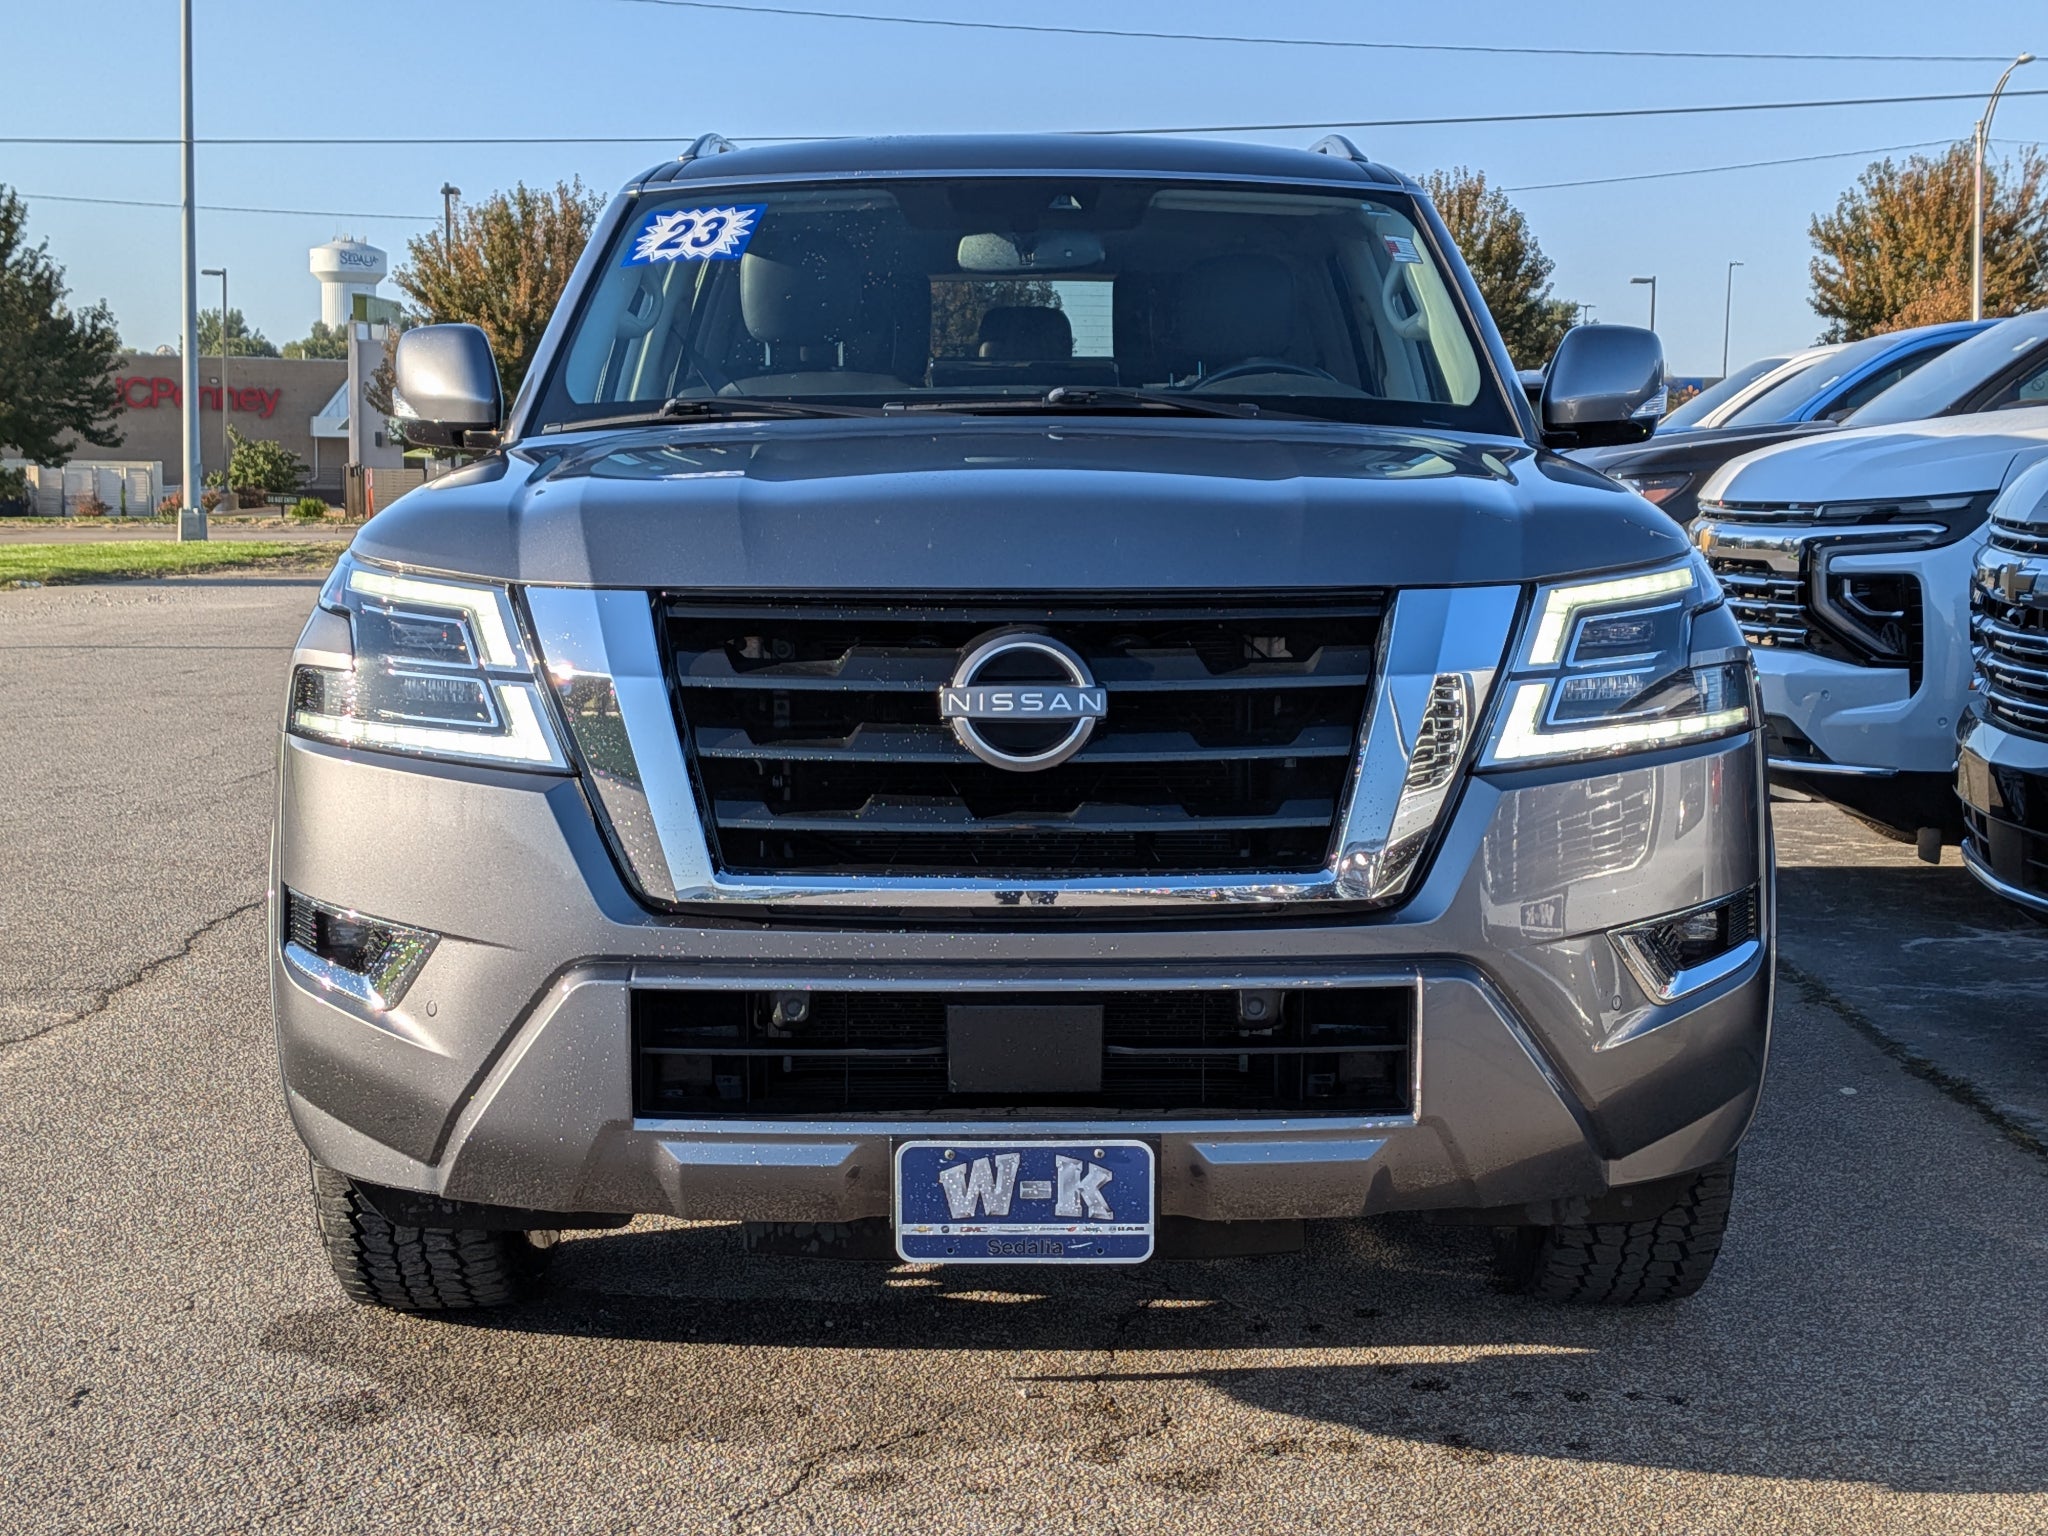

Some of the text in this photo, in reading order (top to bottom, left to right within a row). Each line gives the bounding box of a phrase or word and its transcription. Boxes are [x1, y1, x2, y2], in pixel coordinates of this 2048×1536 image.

[655, 216, 728, 251] 23
[948, 693, 1101, 712] NISSAN
[938, 1152, 1114, 1220] W-K
[987, 1239, 1064, 1256] Sedalia
